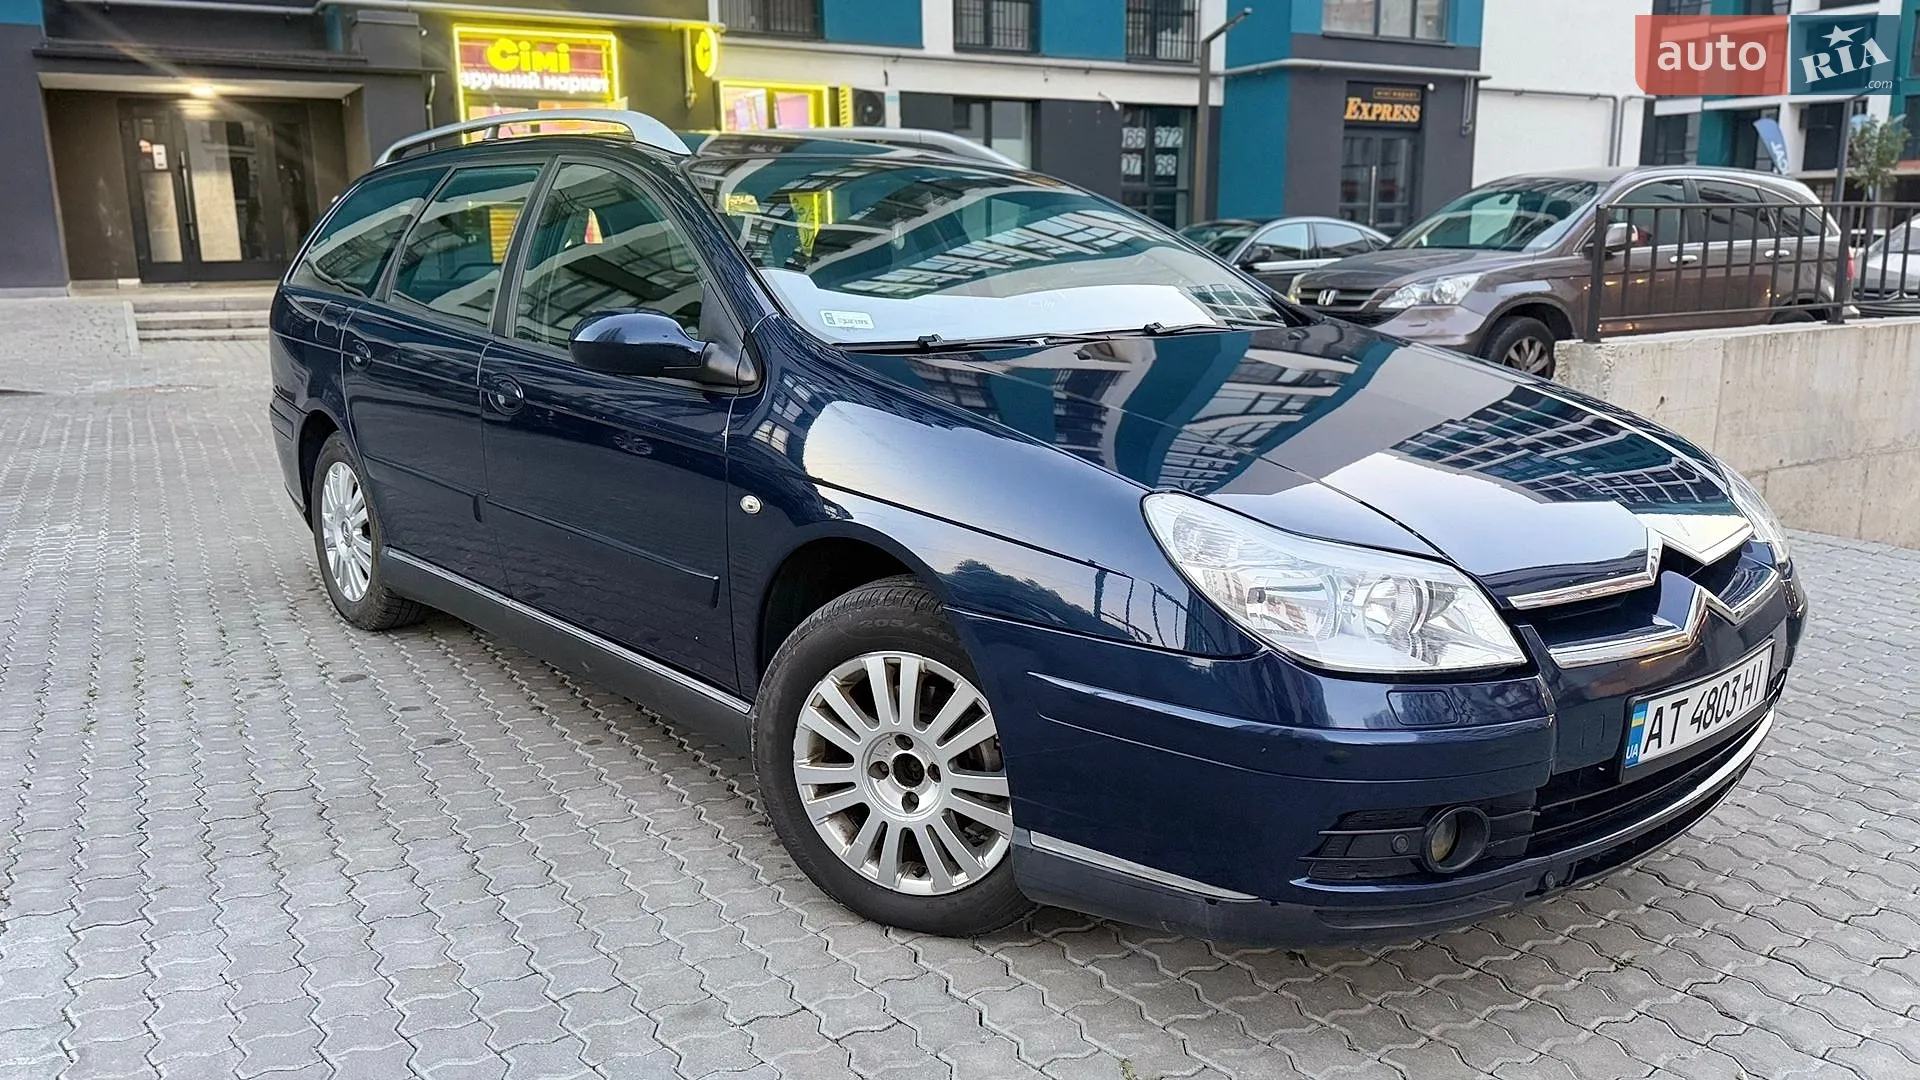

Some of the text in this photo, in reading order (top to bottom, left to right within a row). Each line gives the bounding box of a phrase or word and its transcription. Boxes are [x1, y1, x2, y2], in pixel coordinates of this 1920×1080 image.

[486, 38, 570, 72] Сімі
[543, 74, 609, 94] маркет
[1344, 97, 1420, 122] EXPRESS
[1643, 698, 1688, 754] AT
[1690, 672, 1742, 734] 4803
[1625, 743, 1639, 759] UA
